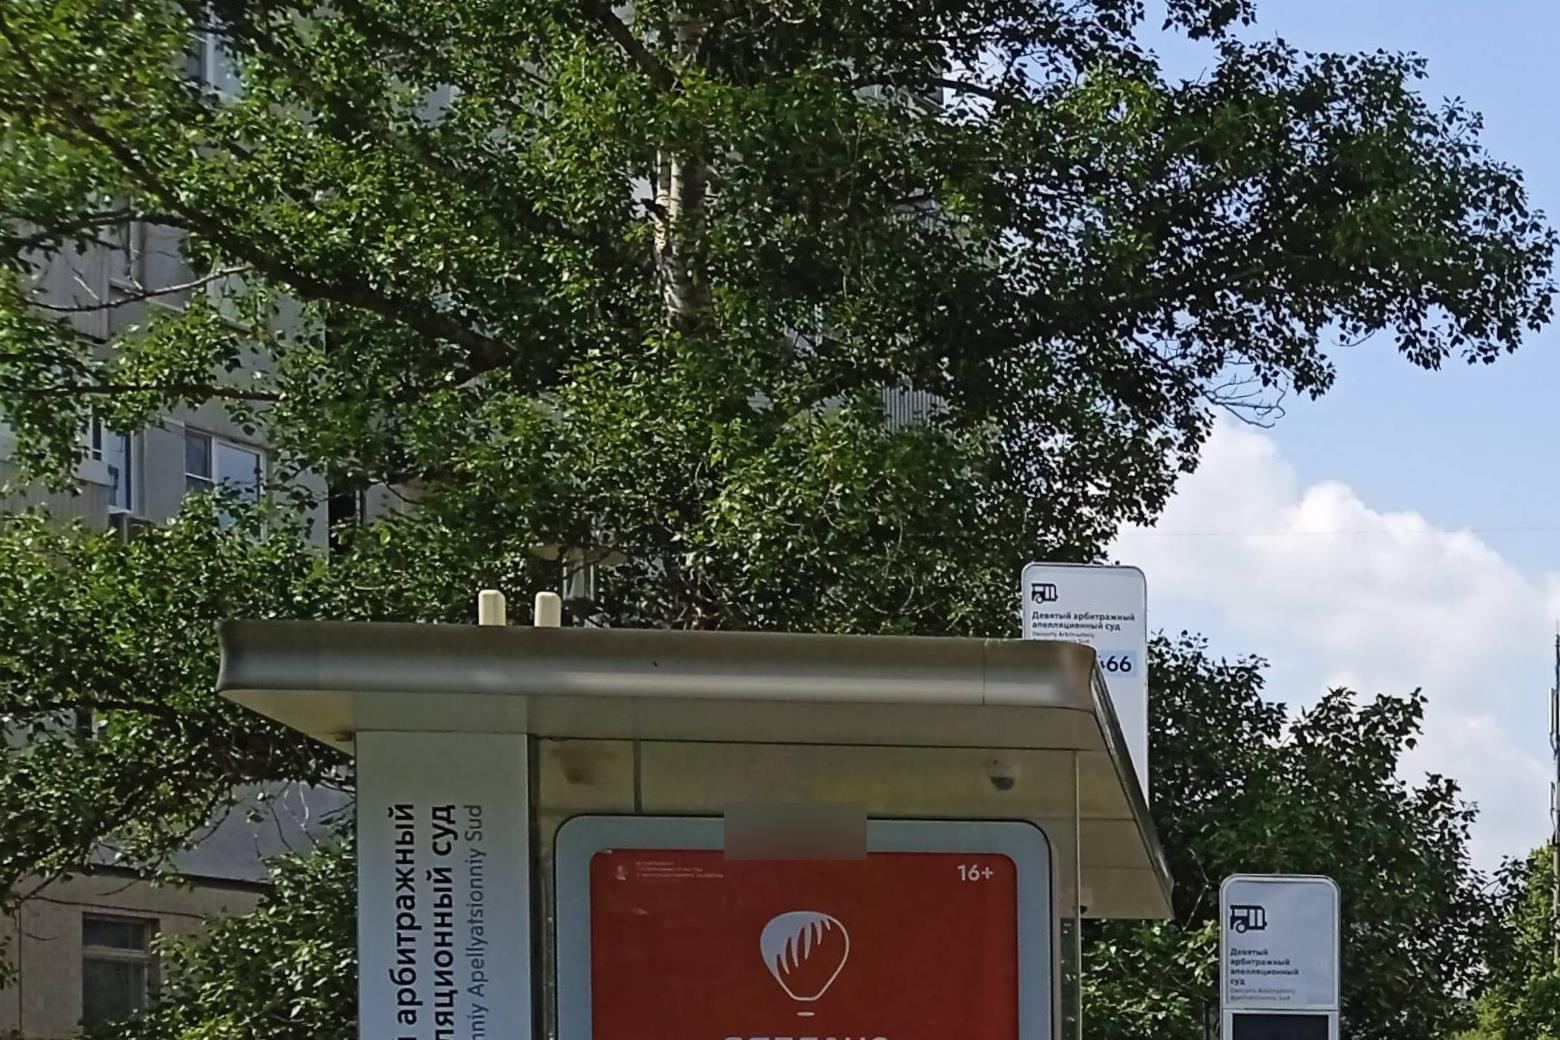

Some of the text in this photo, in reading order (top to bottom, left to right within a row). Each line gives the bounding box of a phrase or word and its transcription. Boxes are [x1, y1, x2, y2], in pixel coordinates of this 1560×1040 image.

[1032, 611, 1135, 622] Девятый арбитражный
[1032, 621, 1121, 632] апелляционный суд
[1098, 655, 1132, 673] 66
[432, 804, 459, 857] суд
[463, 804, 483, 842] Sud
[957, 864, 994, 881] 16+
[387, 804, 424, 1025] арбитражный
[465, 848, 489, 998] Apellyatsionniy
